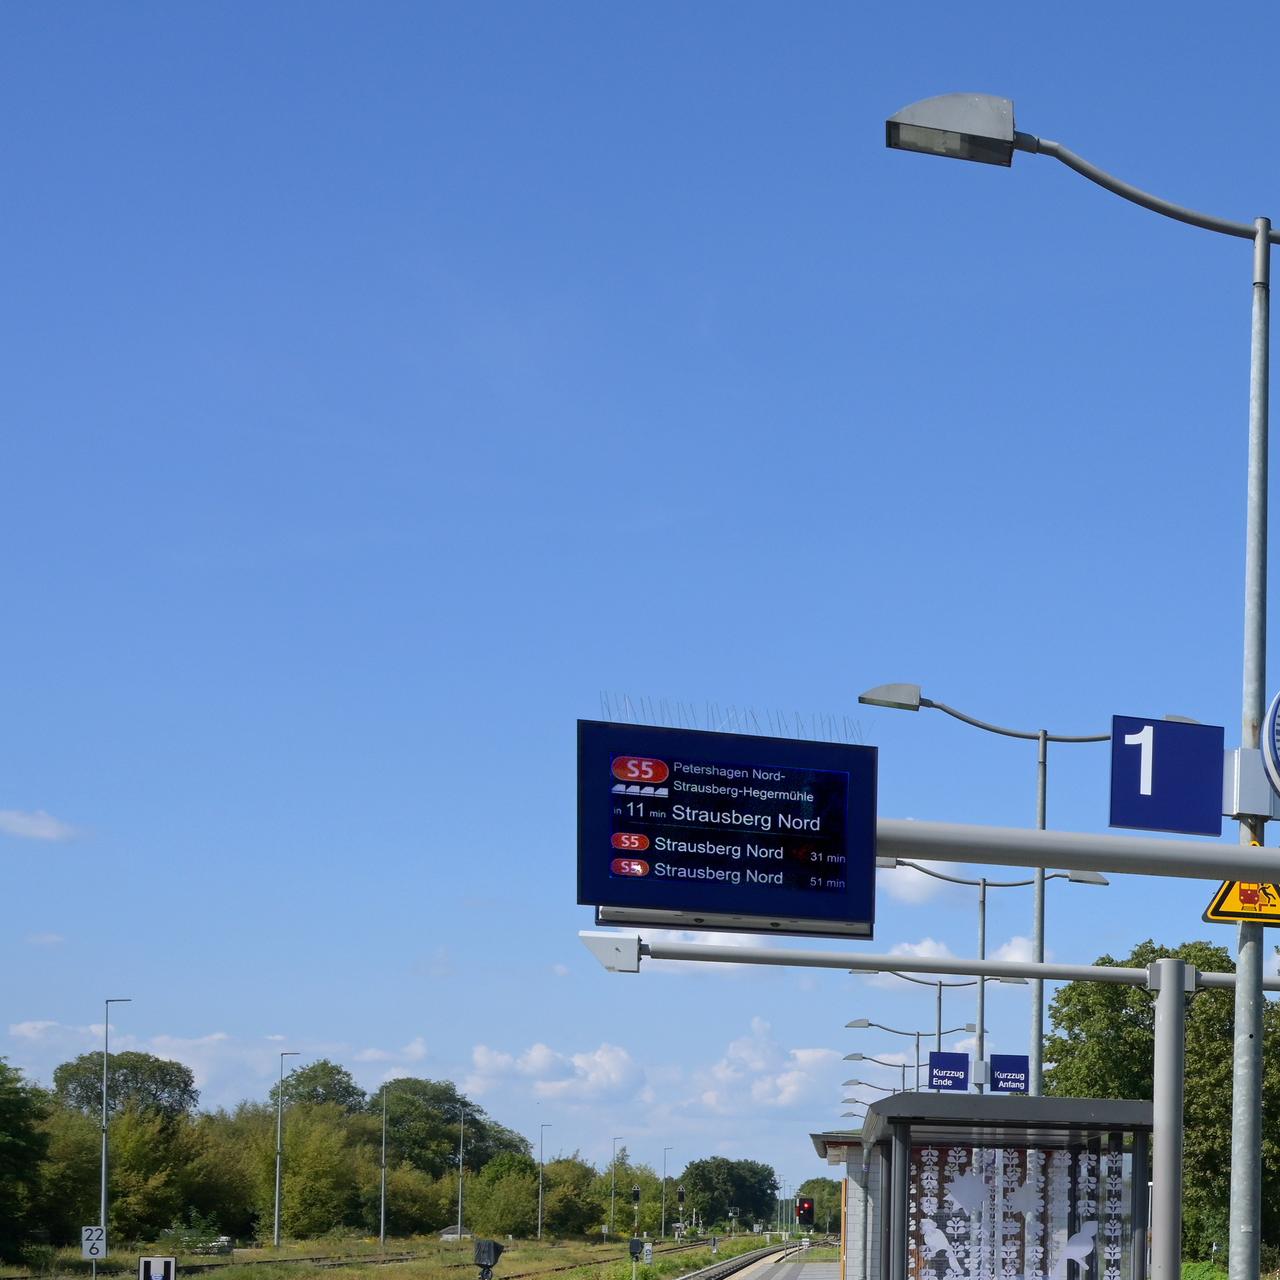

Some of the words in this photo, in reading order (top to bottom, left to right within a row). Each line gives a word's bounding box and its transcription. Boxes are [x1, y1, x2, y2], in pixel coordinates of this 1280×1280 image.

[1124, 725, 1154, 796] 1
[626, 760, 654, 779] S5
[673, 762, 749, 780] Petershagen
[753, 769, 786, 781] Nord-
[673, 780, 814, 802] Strausberg-Hegermühle
[613, 807, 622, 815] in
[626, 802, 644, 817] 11
[649, 809, 667, 819] min
[672, 804, 772, 831] Strausberg
[778, 813, 820, 831] Nord
[621, 835, 639, 848] S5
[654, 837, 741, 859] Strausberg
[746, 844, 784, 859] Nord
[810, 851, 823, 862] 31
[827, 854, 846, 863] min
[621, 861, 640, 873] S5
[654, 862, 741, 885] Strausberg
[746, 869, 784, 884] Nord
[810, 876, 823, 887] 51
[826, 879, 846, 888] min
[933, 1068, 965, 1079] Kurzzug
[994, 1071, 1025, 1080] Kurzzug
[932, 1078, 953, 1087] Ende
[998, 1081, 1025, 1090] Anfang
[84, 1228, 104, 1241] 22
[89, 1242, 99, 1255] 6
